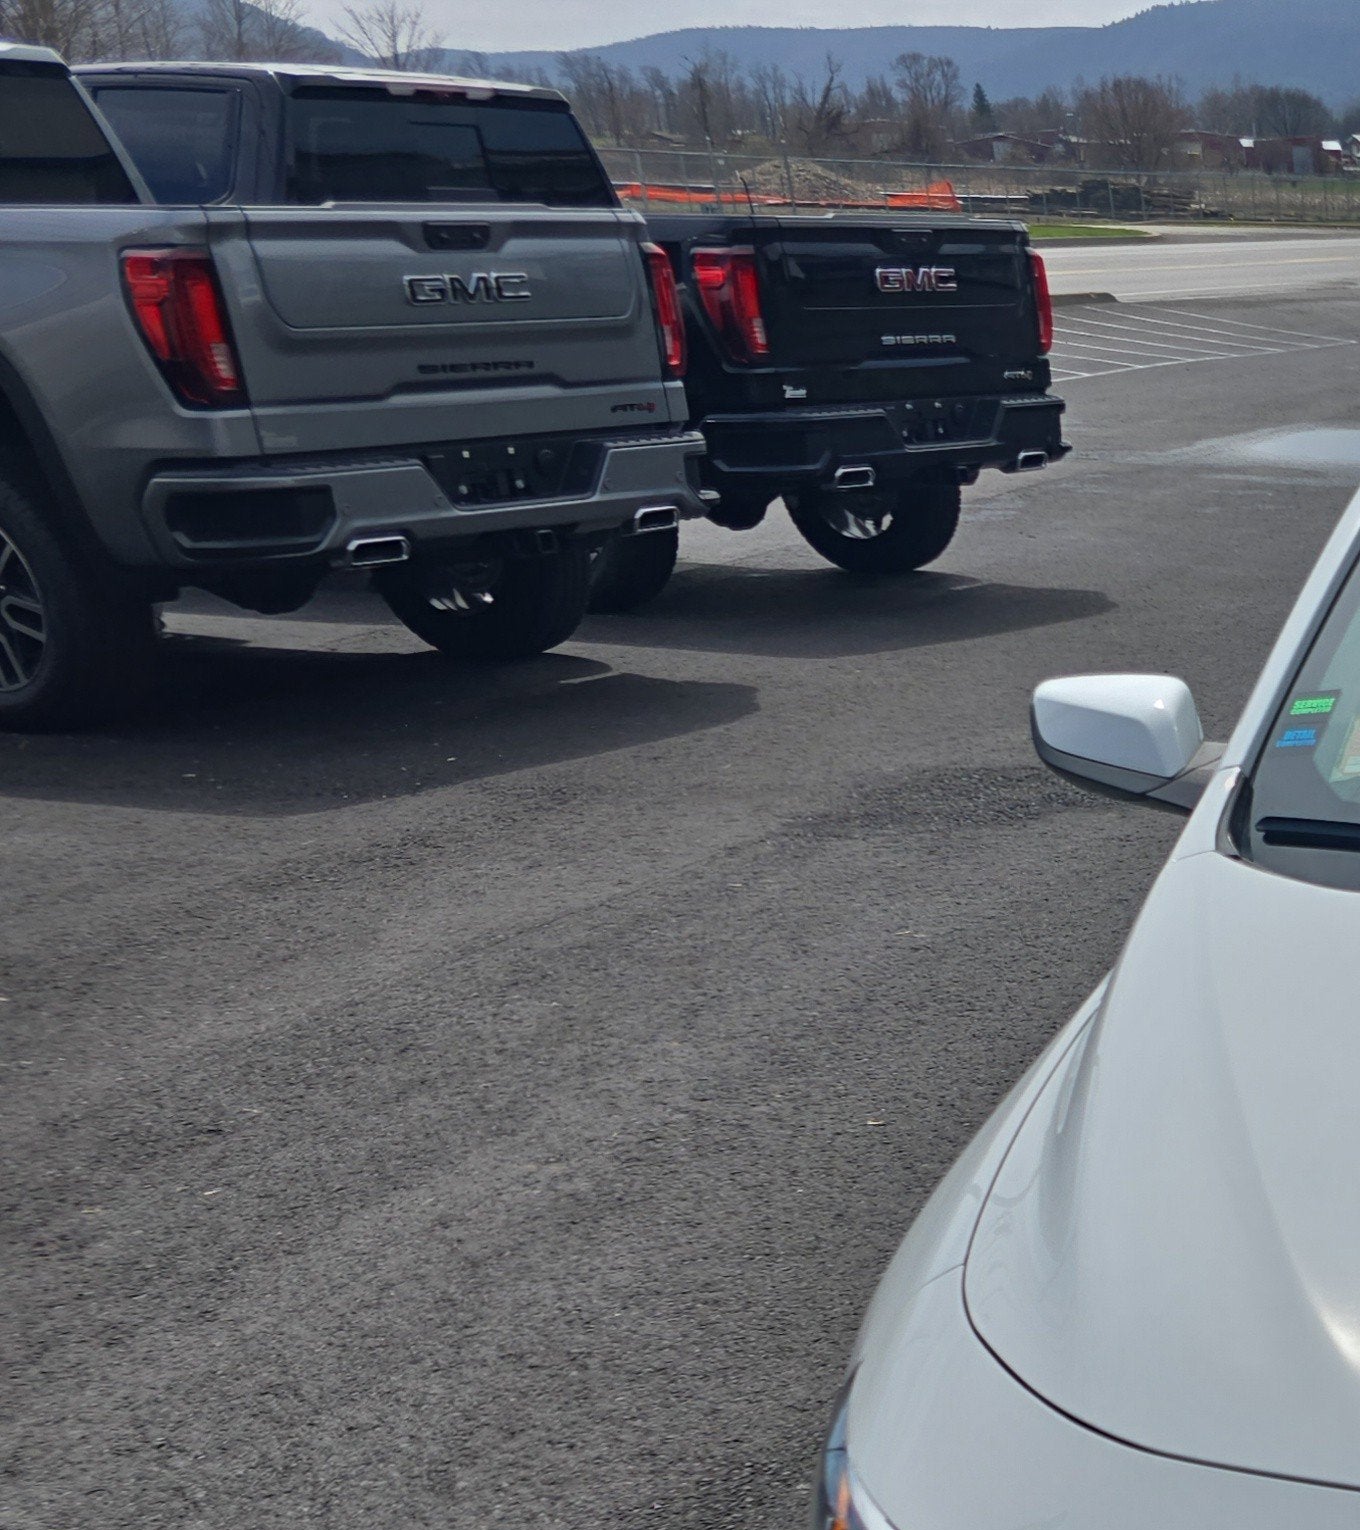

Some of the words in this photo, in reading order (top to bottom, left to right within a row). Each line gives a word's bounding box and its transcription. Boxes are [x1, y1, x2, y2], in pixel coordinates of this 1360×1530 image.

[402, 271, 532, 305] GMC
[875, 265, 958, 292] GMC
[880, 333, 957, 346] SIERRA
[416, 359, 536, 375] SIERRA
